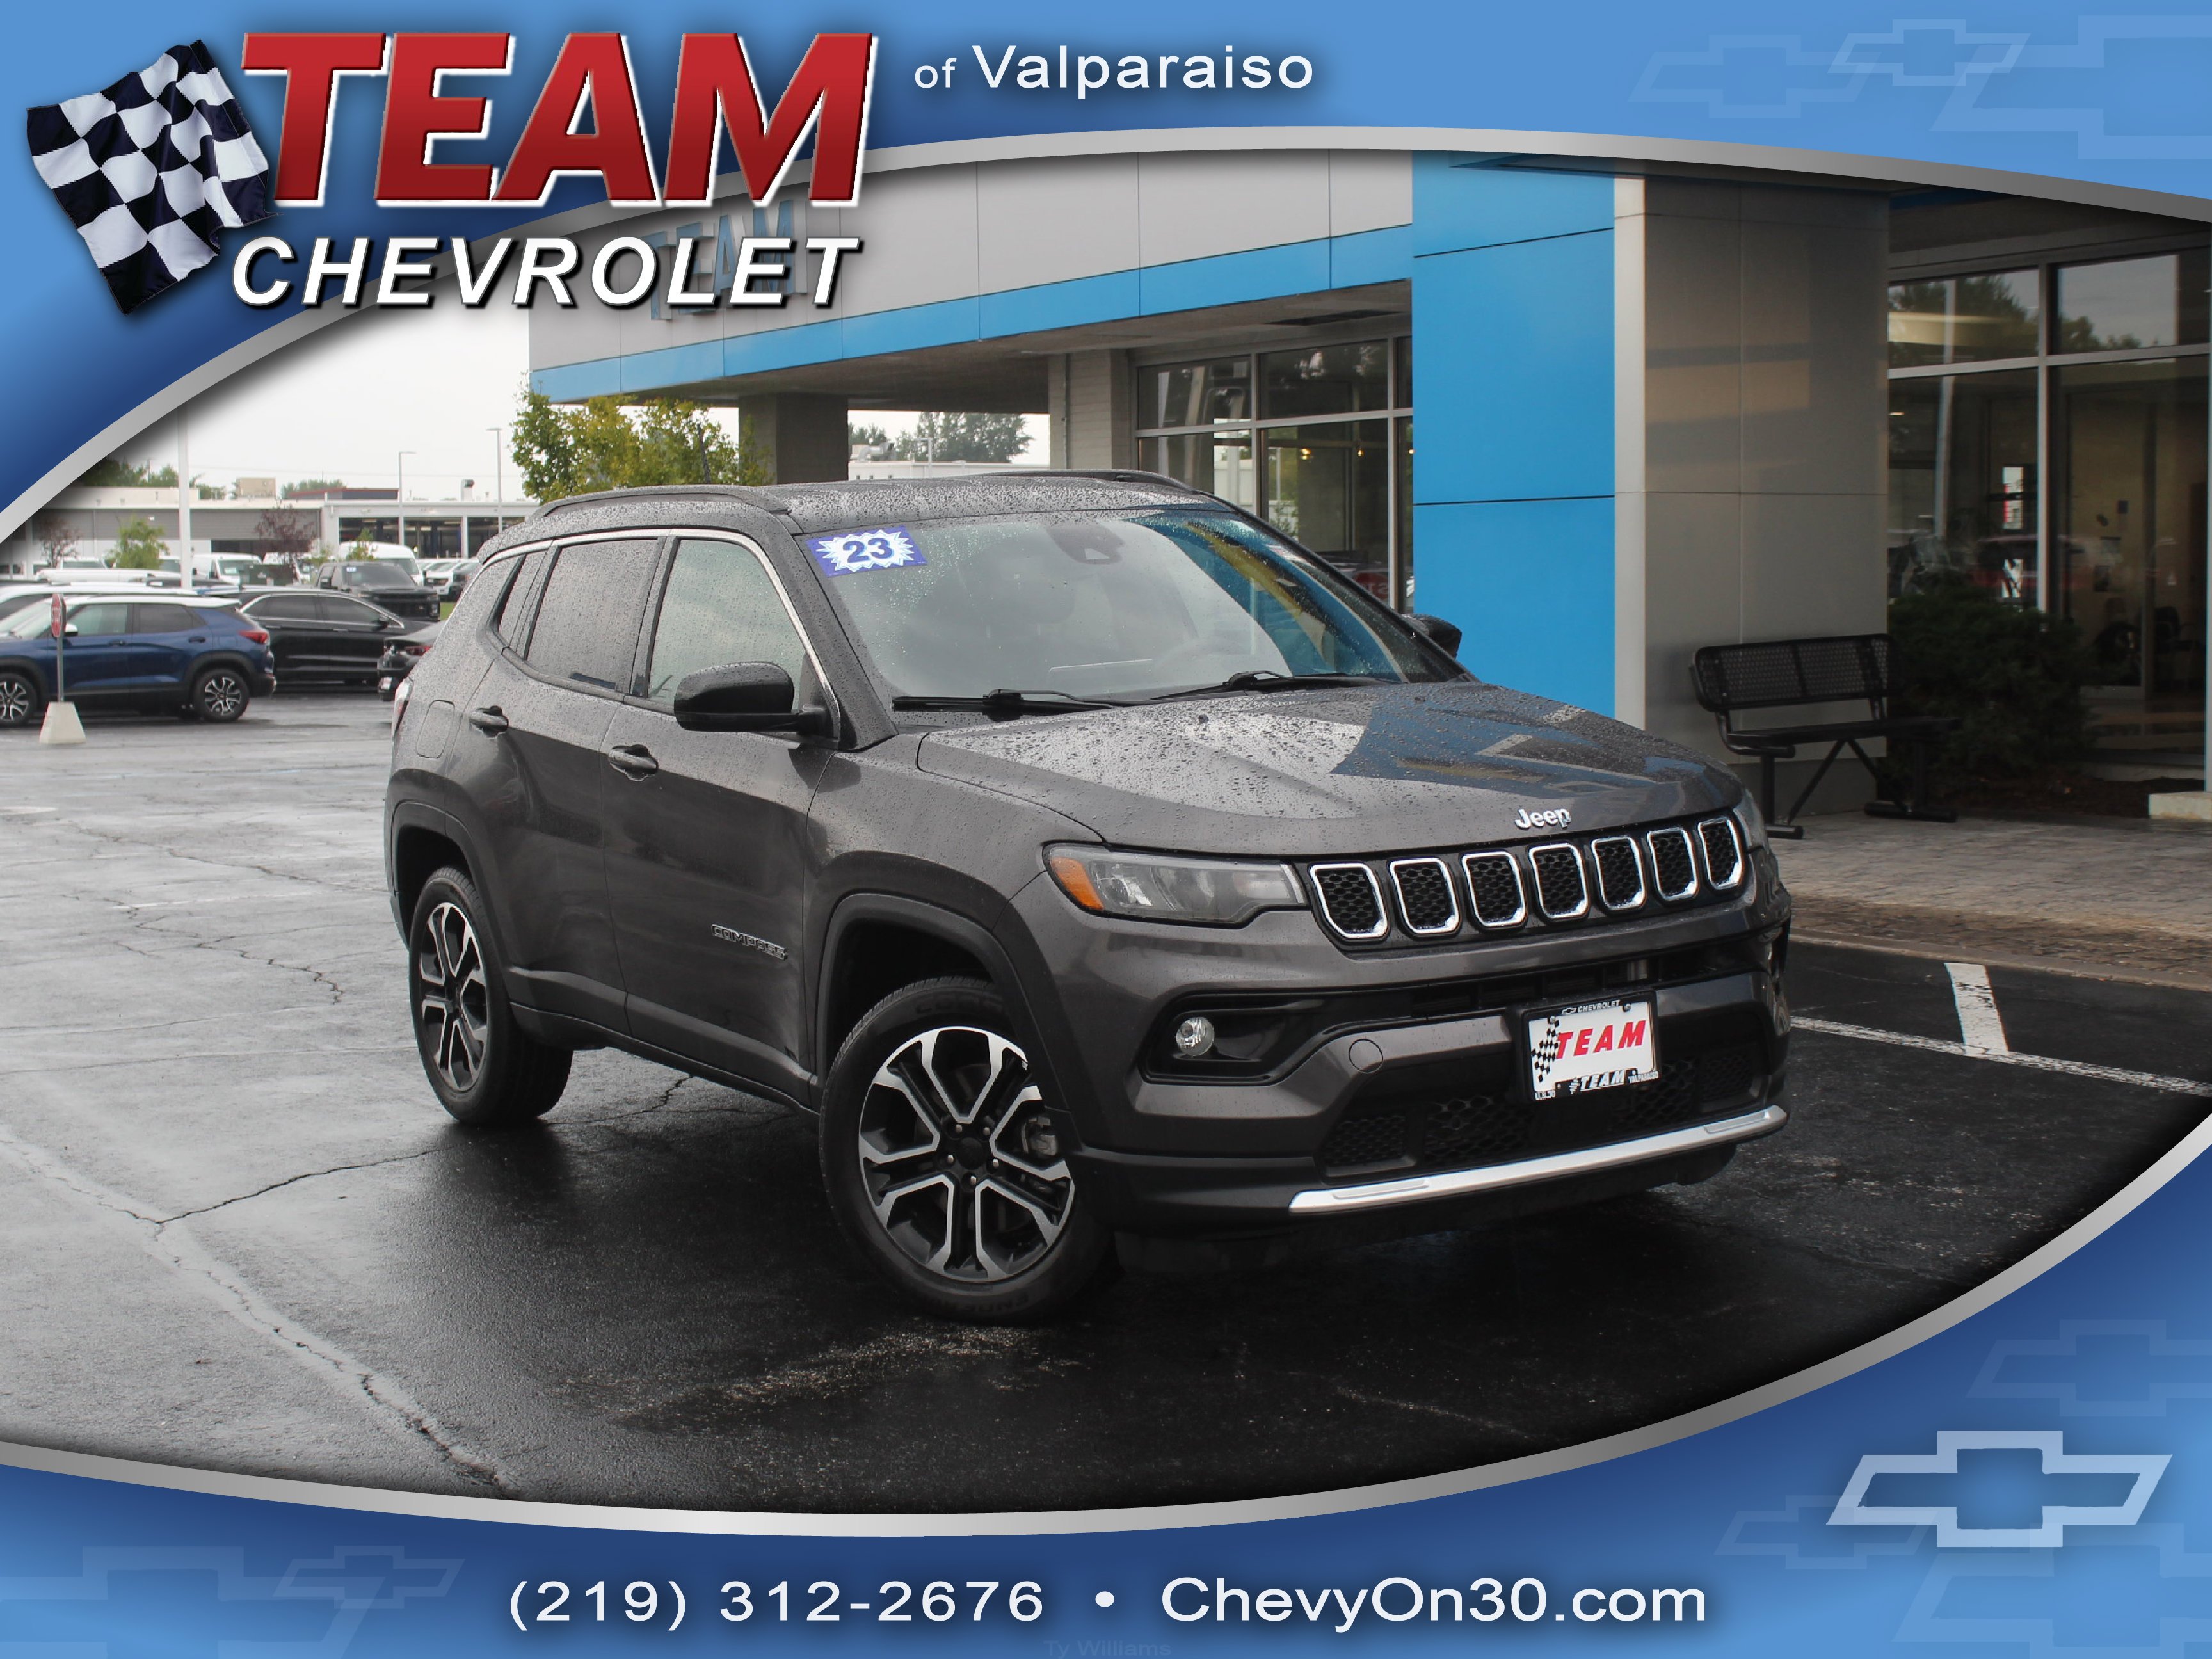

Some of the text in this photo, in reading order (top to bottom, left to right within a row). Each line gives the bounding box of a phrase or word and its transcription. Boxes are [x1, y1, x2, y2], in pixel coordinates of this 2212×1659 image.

[842, 537, 894, 563] 23
[1514, 808, 1572, 830] Jeep
[710, 924, 789, 960] COMPASS
[1577, 999, 1621, 1013] CHEVROLET
[1555, 1020, 1646, 1059] TEAM
[1580, 1070, 1626, 1091] TEAM
